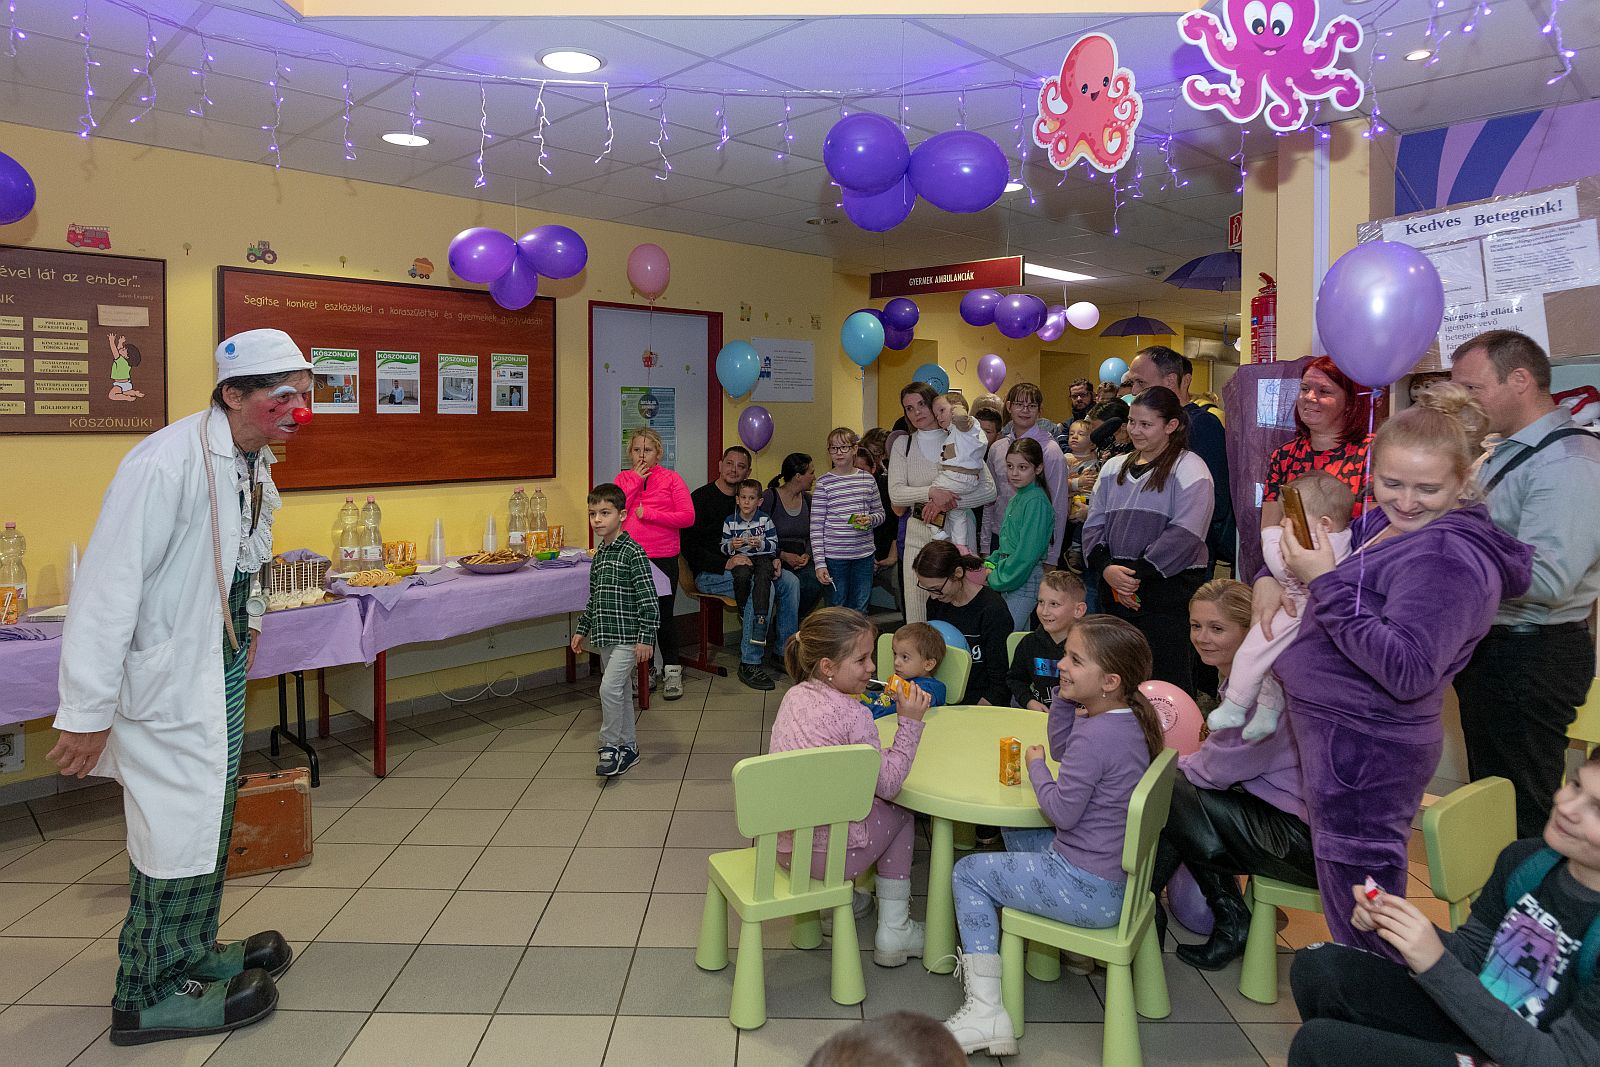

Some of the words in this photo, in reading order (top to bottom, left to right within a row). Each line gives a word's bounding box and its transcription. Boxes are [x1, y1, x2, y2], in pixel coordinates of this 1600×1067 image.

[1405, 216, 1461, 235] Kedves
[1474, 199, 1563, 227] Betegeink!
[38, 267, 56, 281] lát
[63, 273, 79, 283] az
[909, 276, 933, 287] GYERMEK
[934, 270, 974, 284] AMBULANCIÁK
[244, 295, 279, 307] Segítse
[286, 298, 317, 309] konkrét
[324, 303, 373, 314] eszközökkel
[69, 416, 153, 428] KÖSZÖNJÜK!
